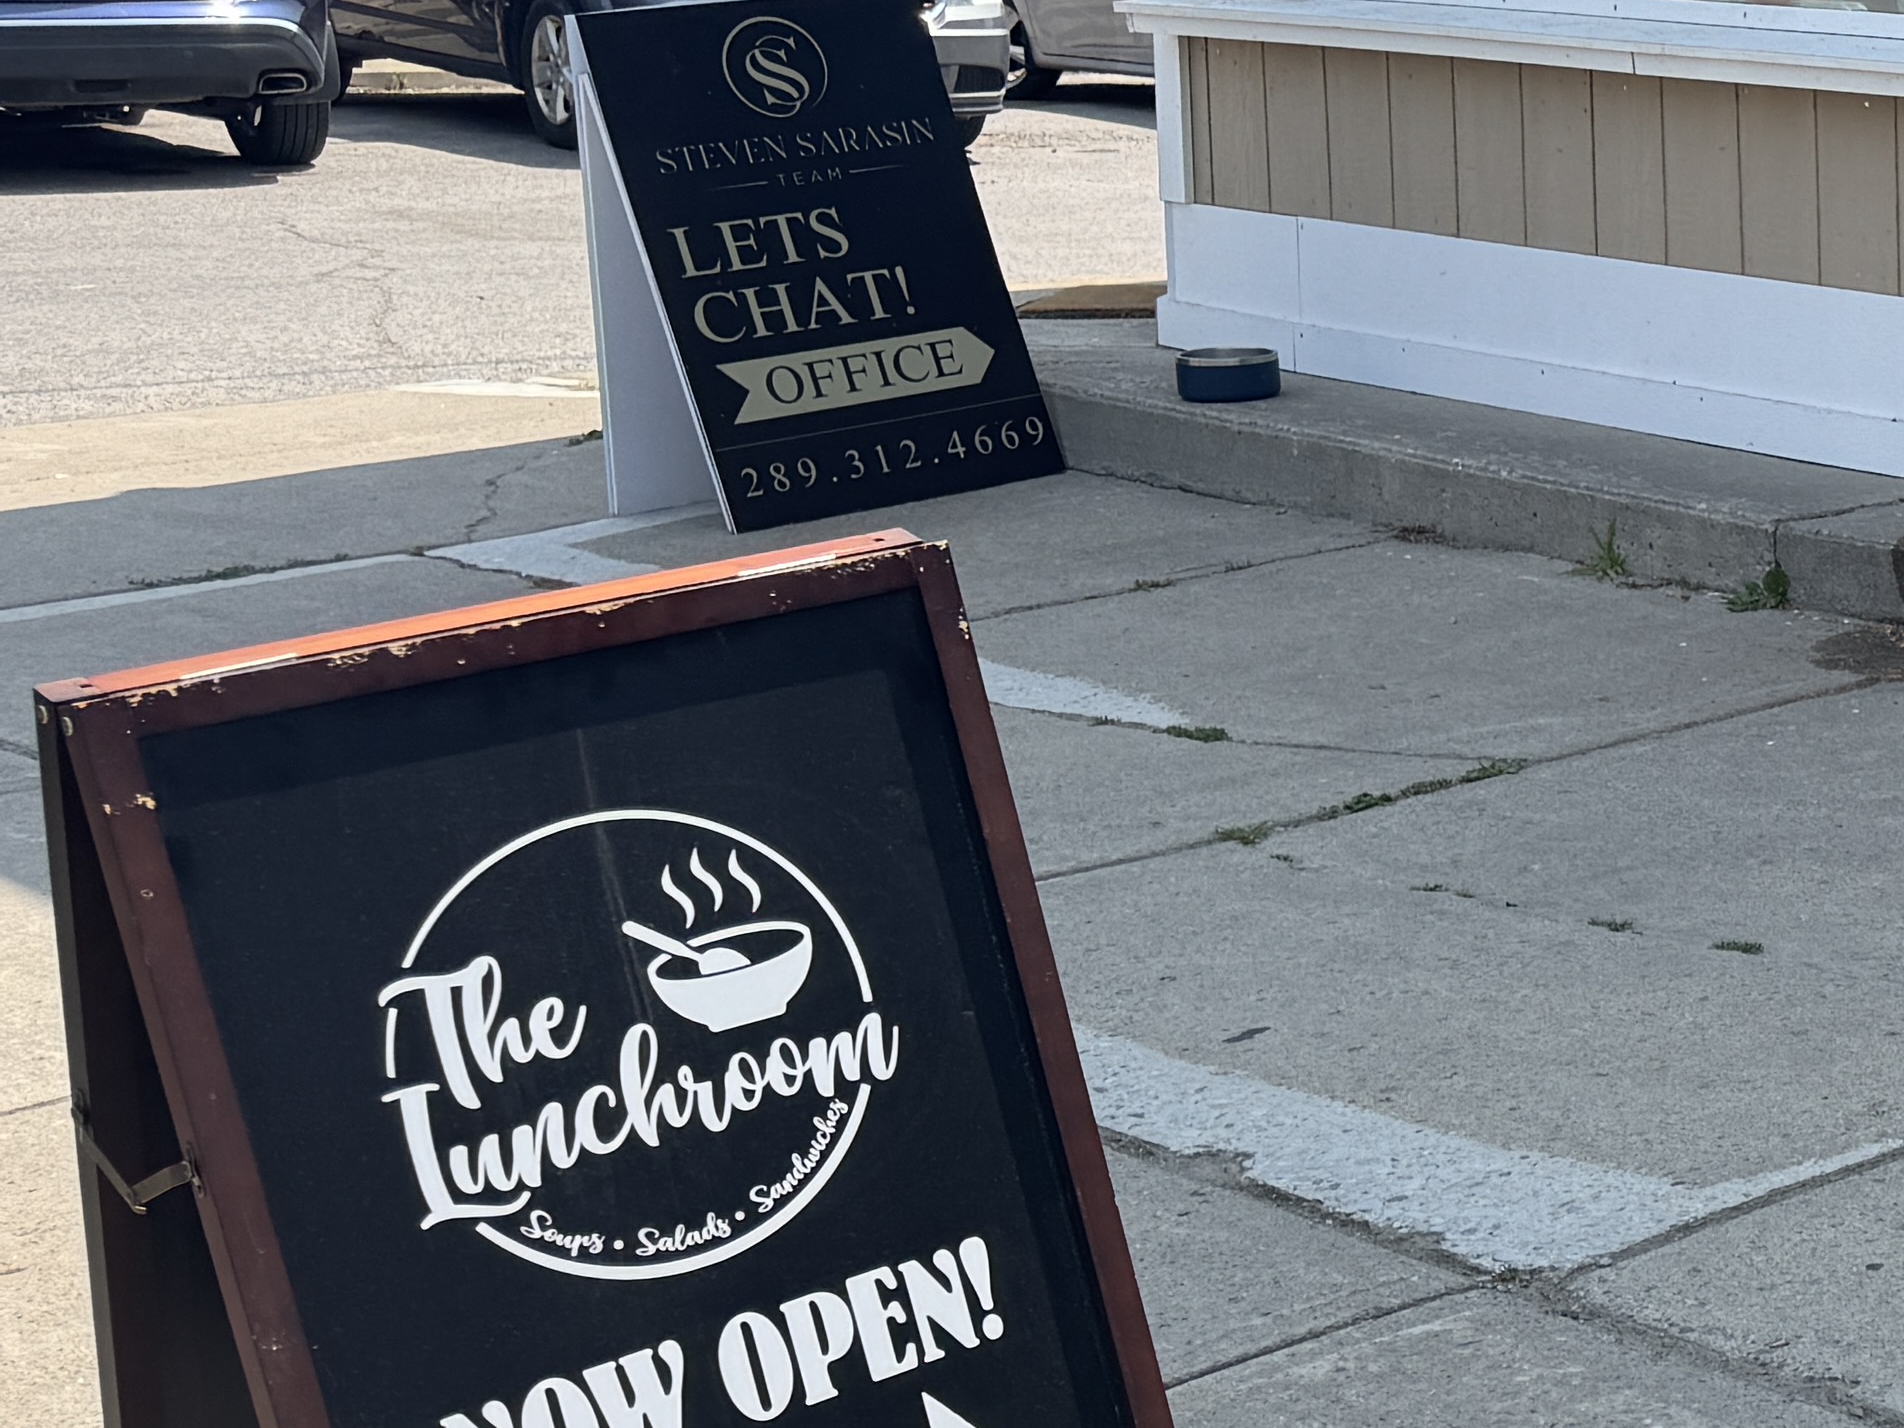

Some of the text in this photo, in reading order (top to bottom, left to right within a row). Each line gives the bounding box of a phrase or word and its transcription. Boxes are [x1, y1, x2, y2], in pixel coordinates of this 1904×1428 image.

[655, 117, 936, 175] STEVEN SARASIN
[776, 166, 843, 187] TEAM
[667, 205, 850, 279] LETS
[693, 265, 918, 344] CHAT!
[765, 340, 965, 405] OFFICE
[740, 416, 1046, 498] 289.312.4669
[378, 955, 585, 1110] The
[381, 1013, 901, 1232] Lunchroom
[520, 1098, 849, 1259] Soups Salads Sandwiches
[717, 1235, 1007, 1424] OPEN!
